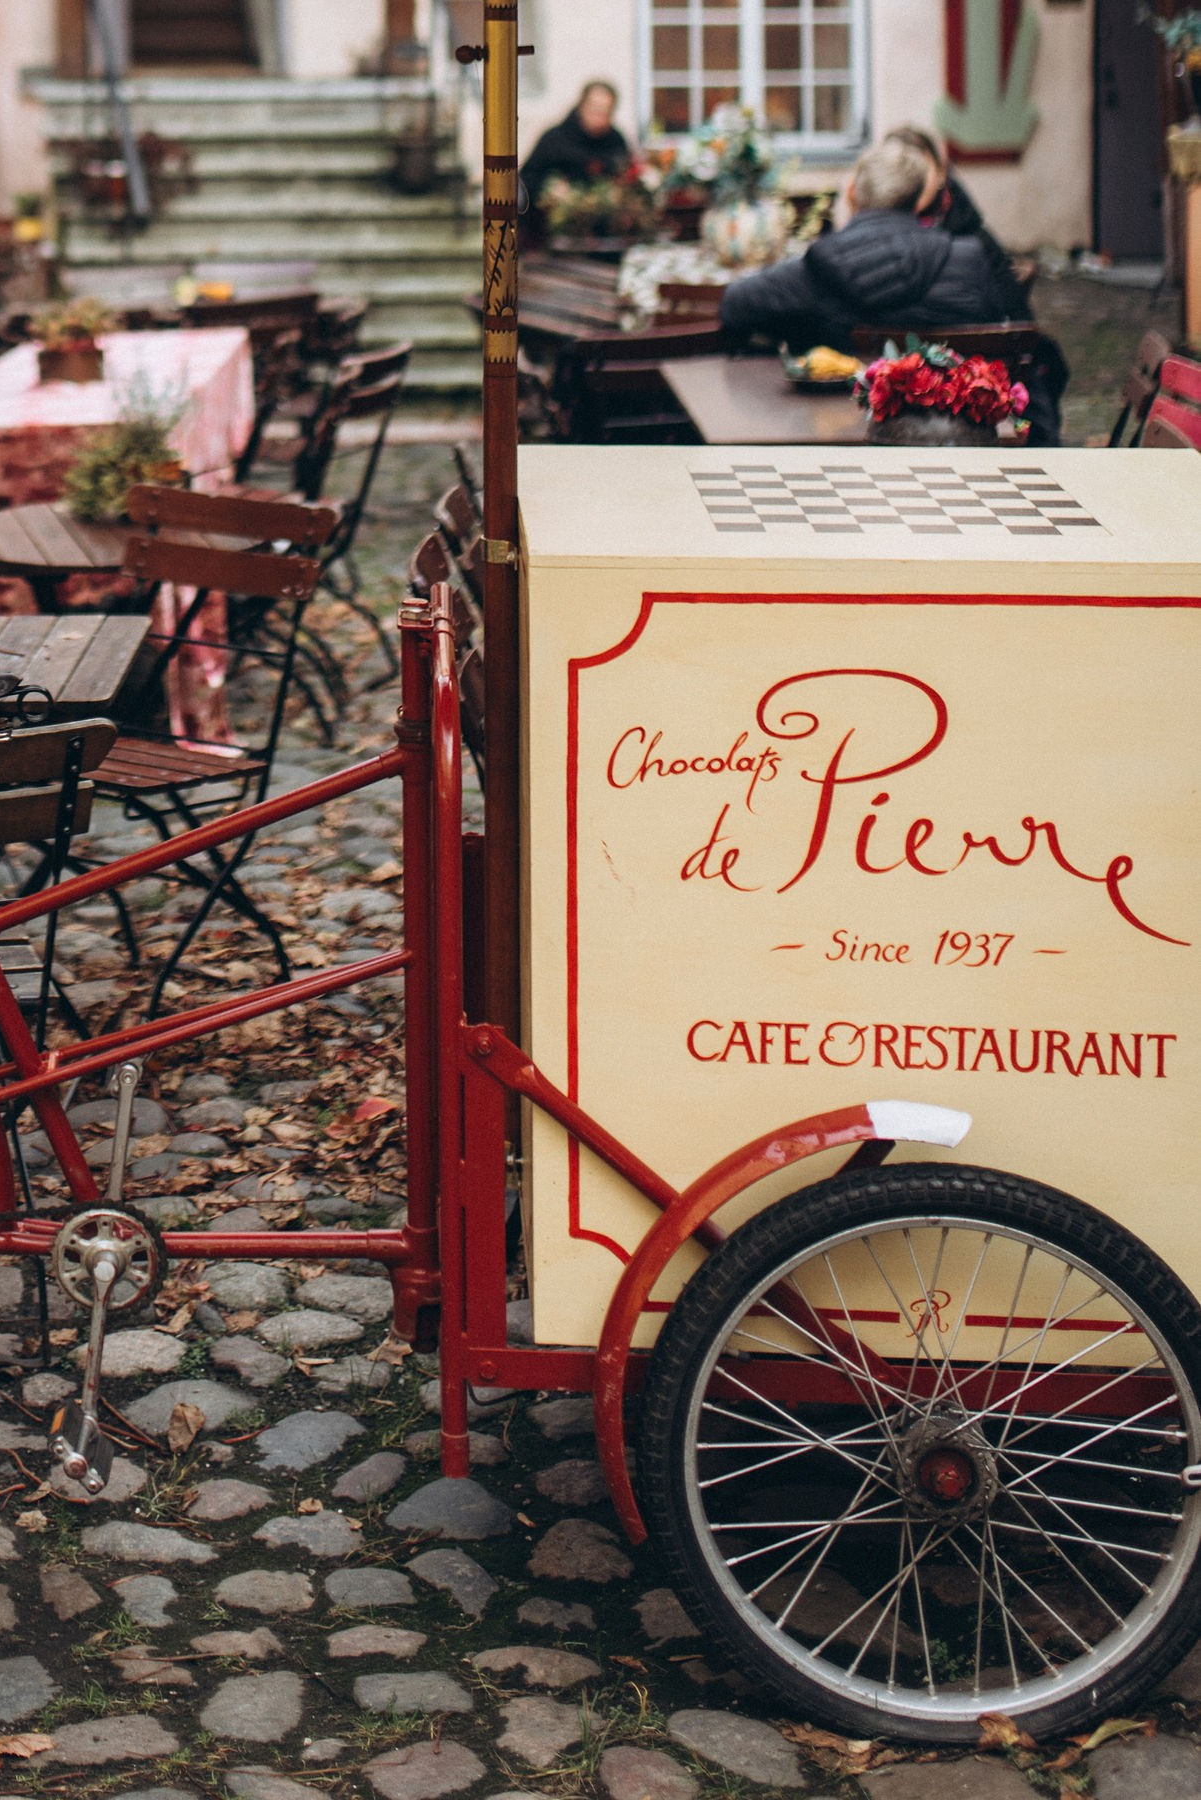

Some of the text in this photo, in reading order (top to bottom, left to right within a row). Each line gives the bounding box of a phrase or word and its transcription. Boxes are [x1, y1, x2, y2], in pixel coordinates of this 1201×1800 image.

[605, 725, 783, 815] Chocolats
[679, 667, 1191, 947] de Pierre
[824, 928, 1015, 968] Since 1937
[685, 1020, 811, 1066] CAFE
[871, 1022, 1179, 1079] RESTAURANT
